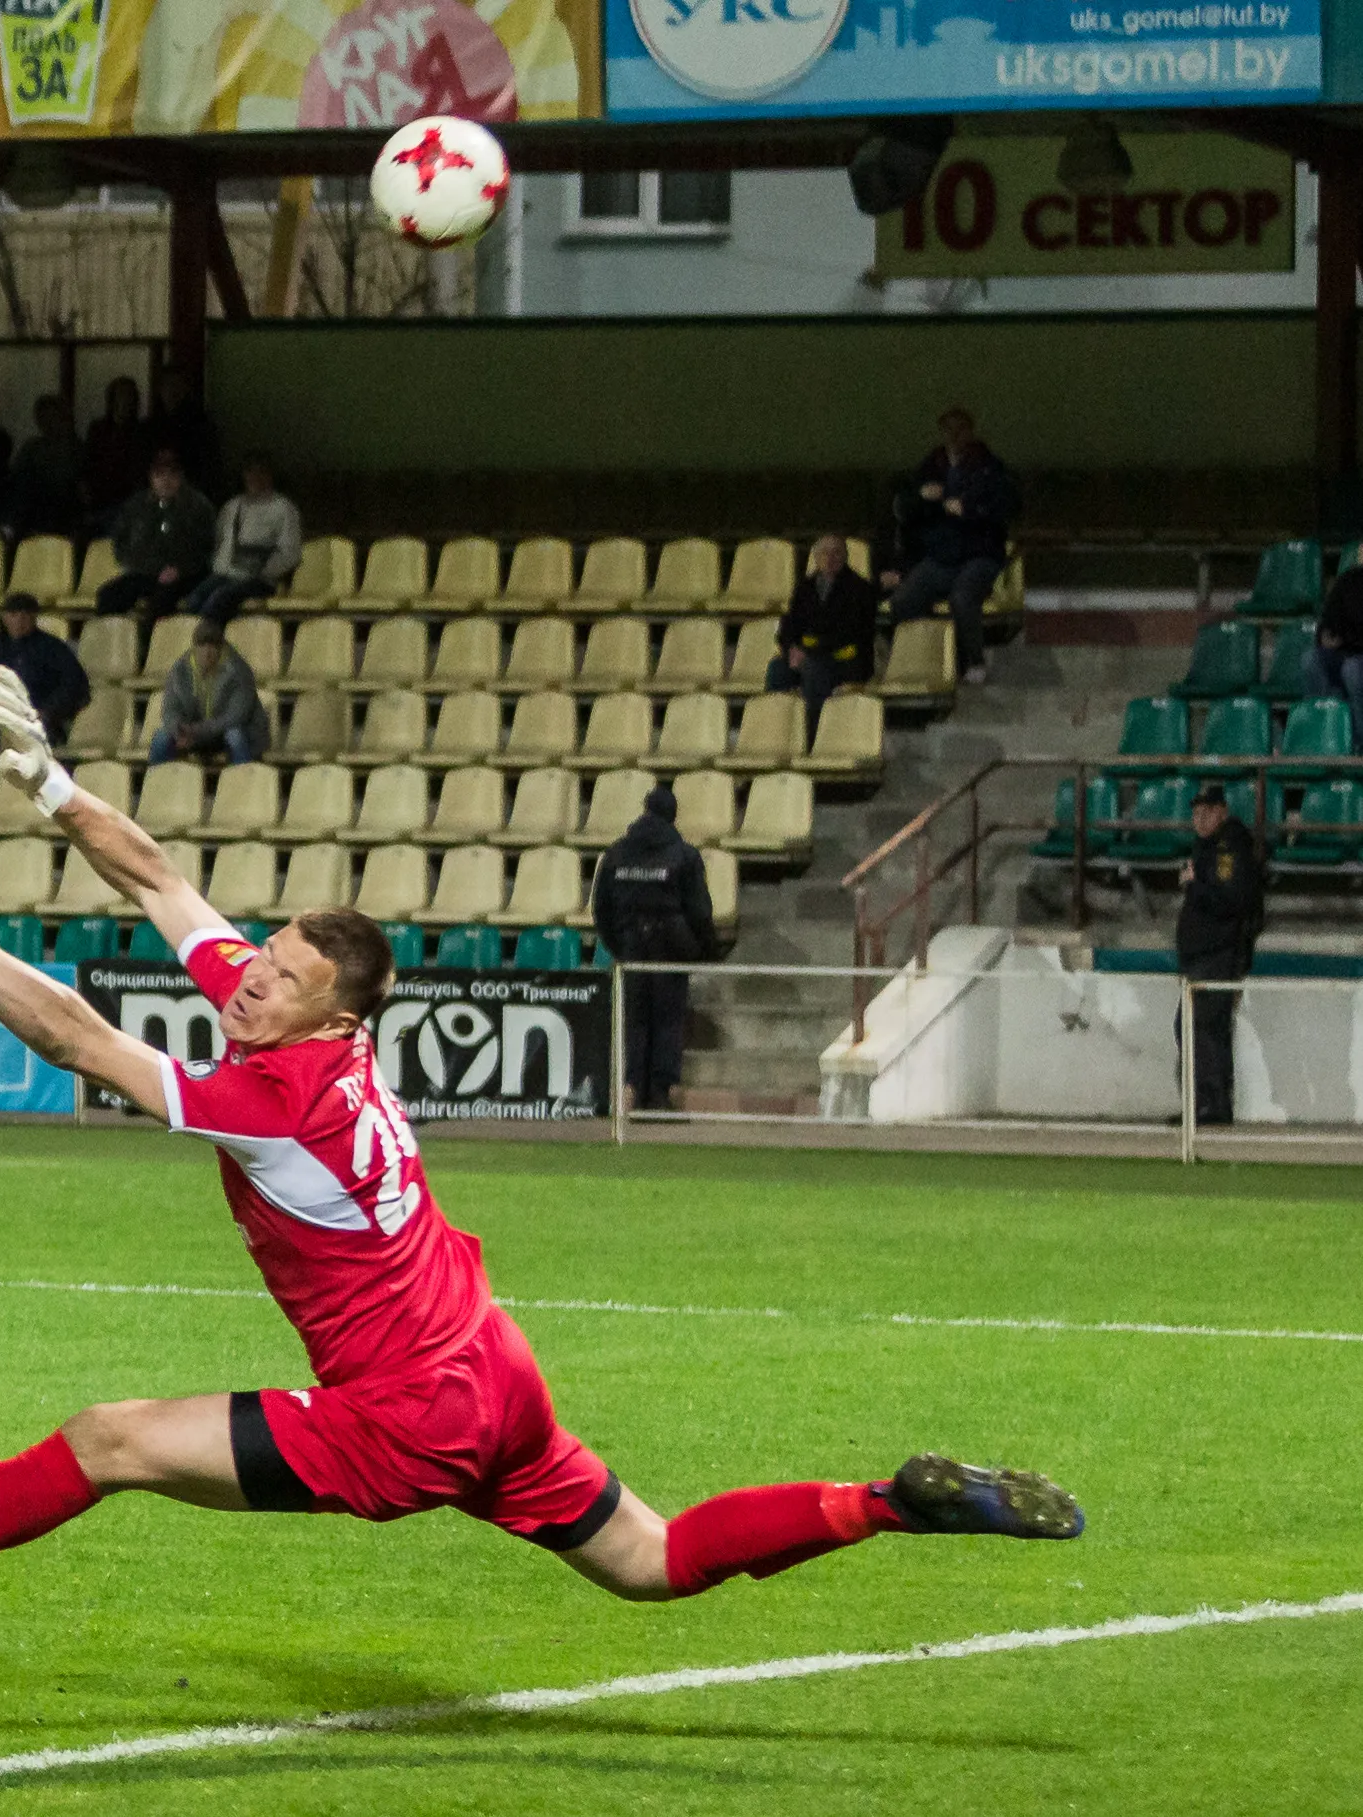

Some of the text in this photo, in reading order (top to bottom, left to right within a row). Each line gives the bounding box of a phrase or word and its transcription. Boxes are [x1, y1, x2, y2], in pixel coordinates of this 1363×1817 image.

[17, 56, 68, 102] ЗА
[996, 37, 1290, 94] uksgomel.by
[902, 160, 1280, 252] 10 СЕКТОР
[393, 981, 464, 1000] еларусь
[470, 981, 510, 999] ООО
